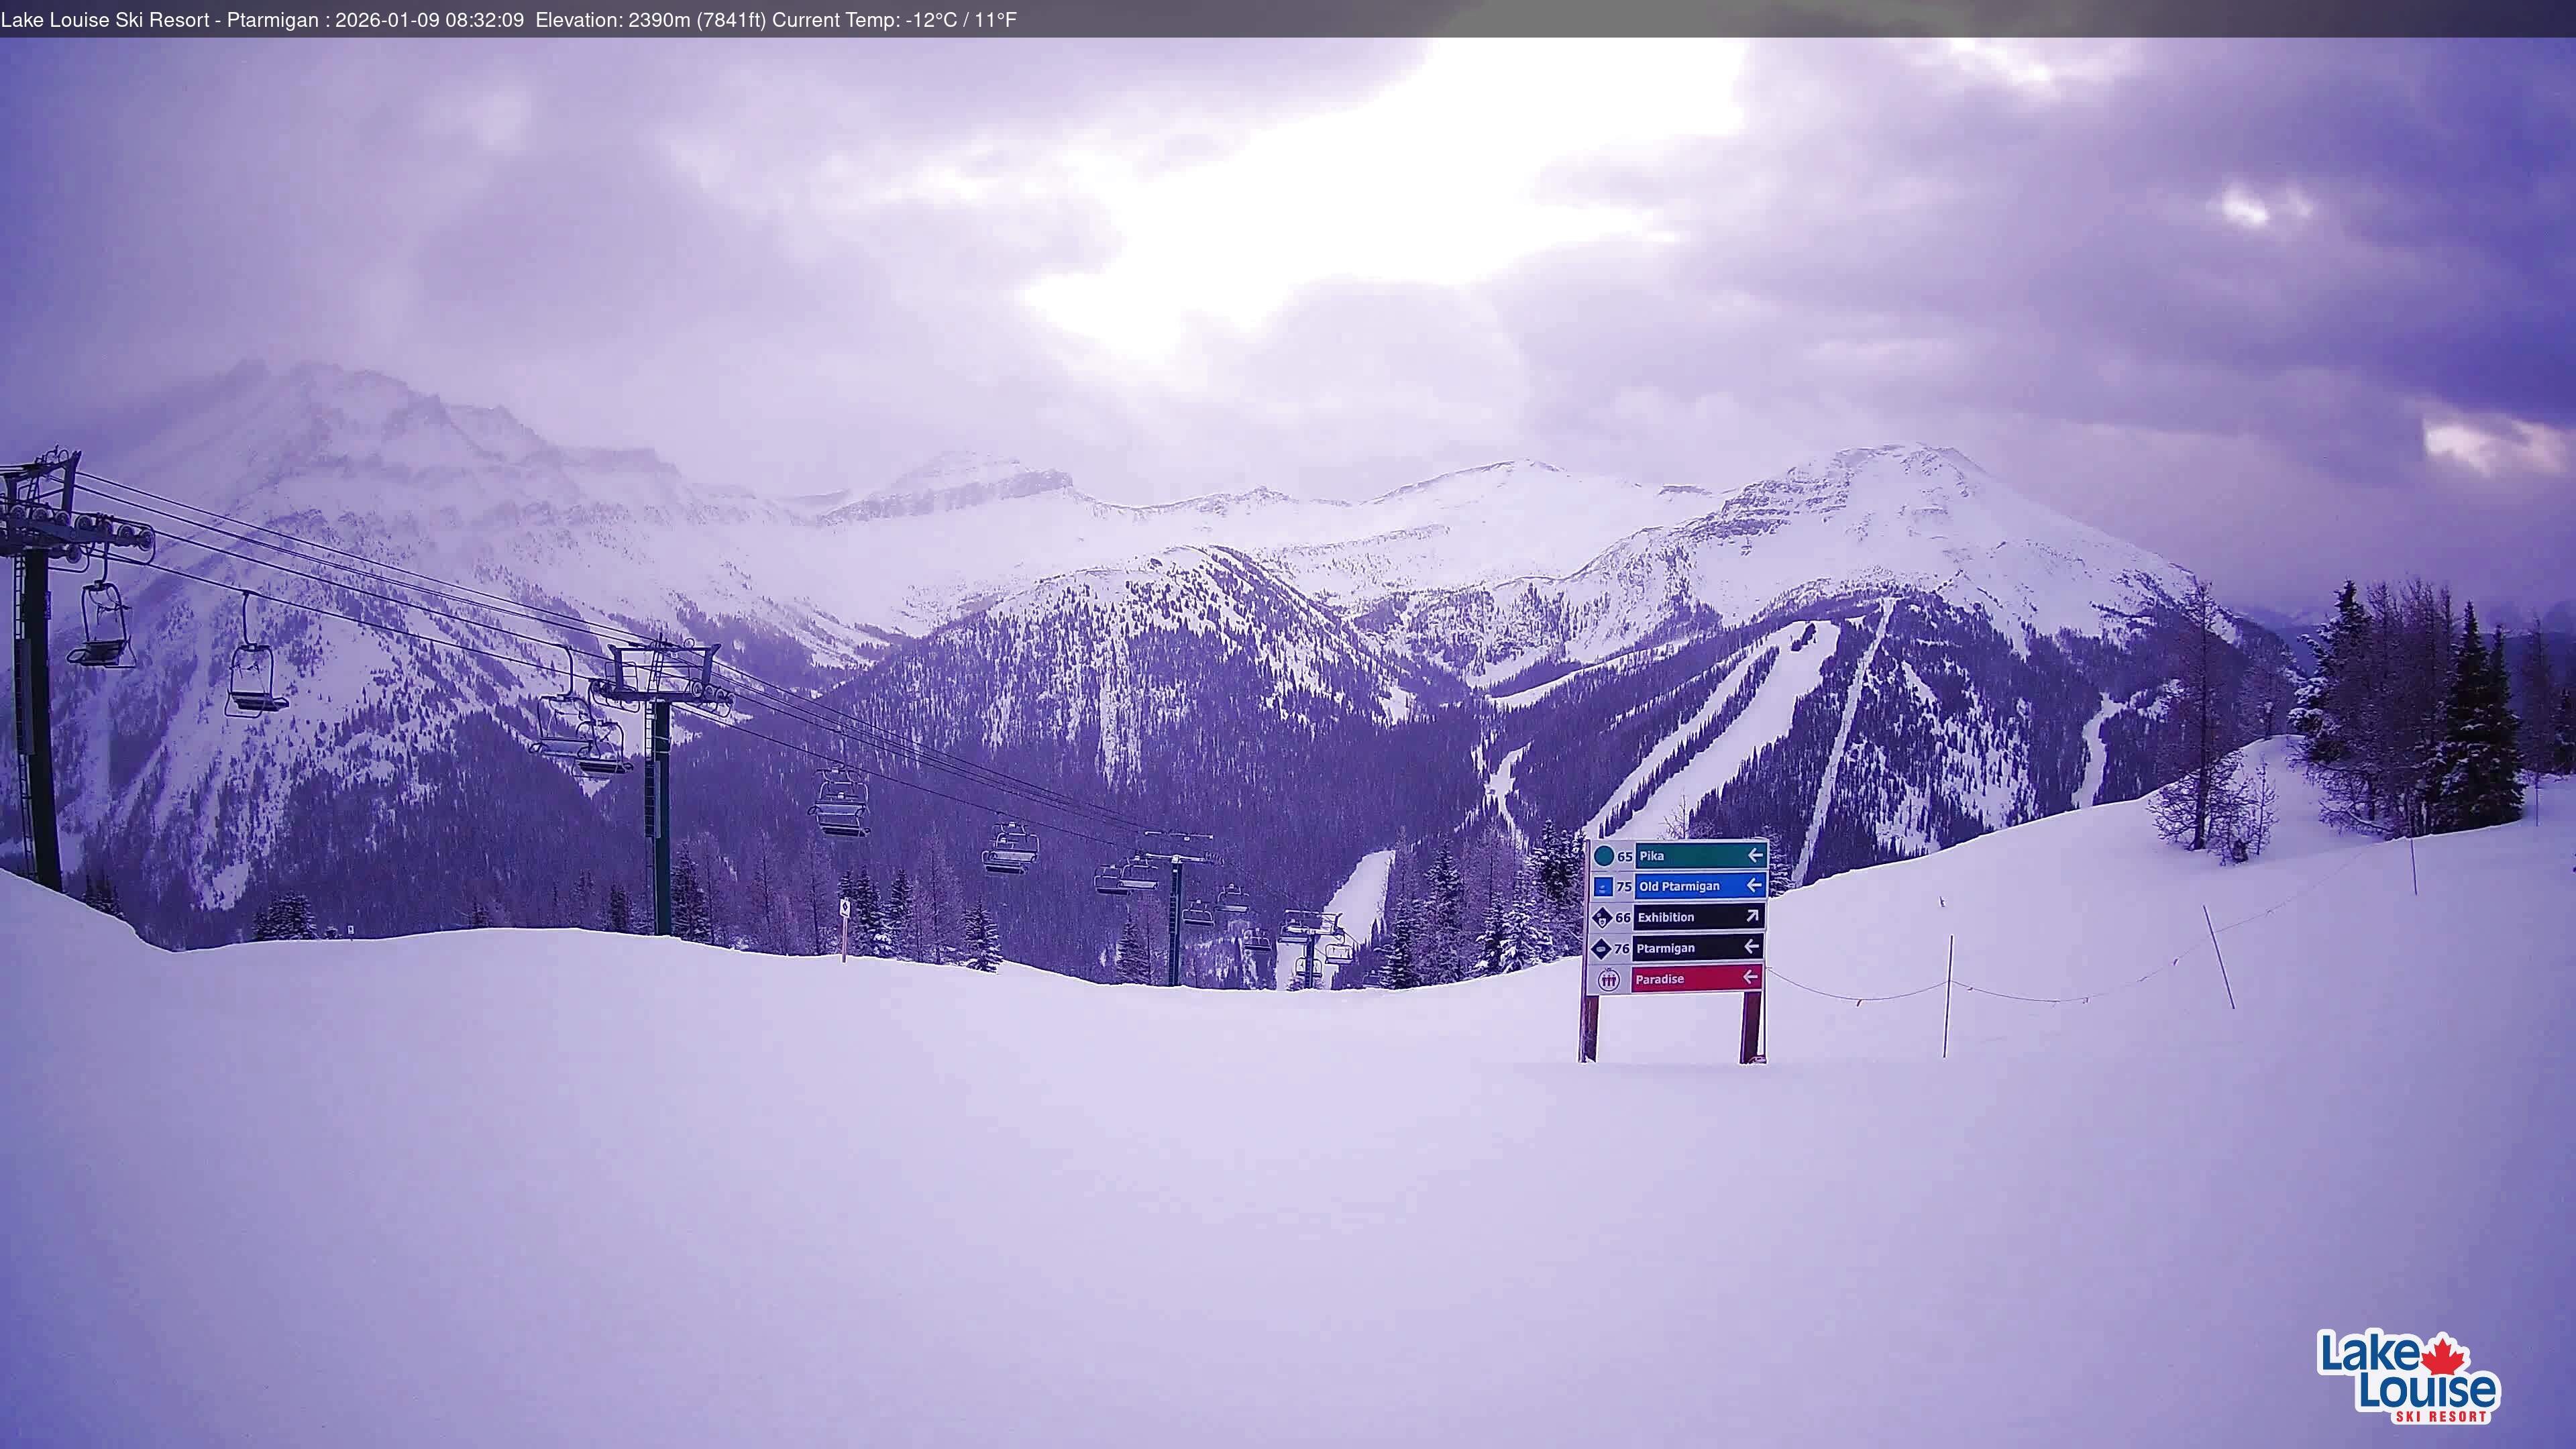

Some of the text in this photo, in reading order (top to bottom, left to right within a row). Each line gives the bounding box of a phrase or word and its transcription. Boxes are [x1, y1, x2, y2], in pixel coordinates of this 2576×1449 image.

[1617, 850, 1665, 862] 65 Pika
[1617, 880, 1721, 893] 75 Old Ptarmigan
[1615, 912, 1695, 923] 66 Exhibition
[1614, 943, 1695, 955] 76 Ptarmigan
[1635, 973, 1684, 985] Paradise
